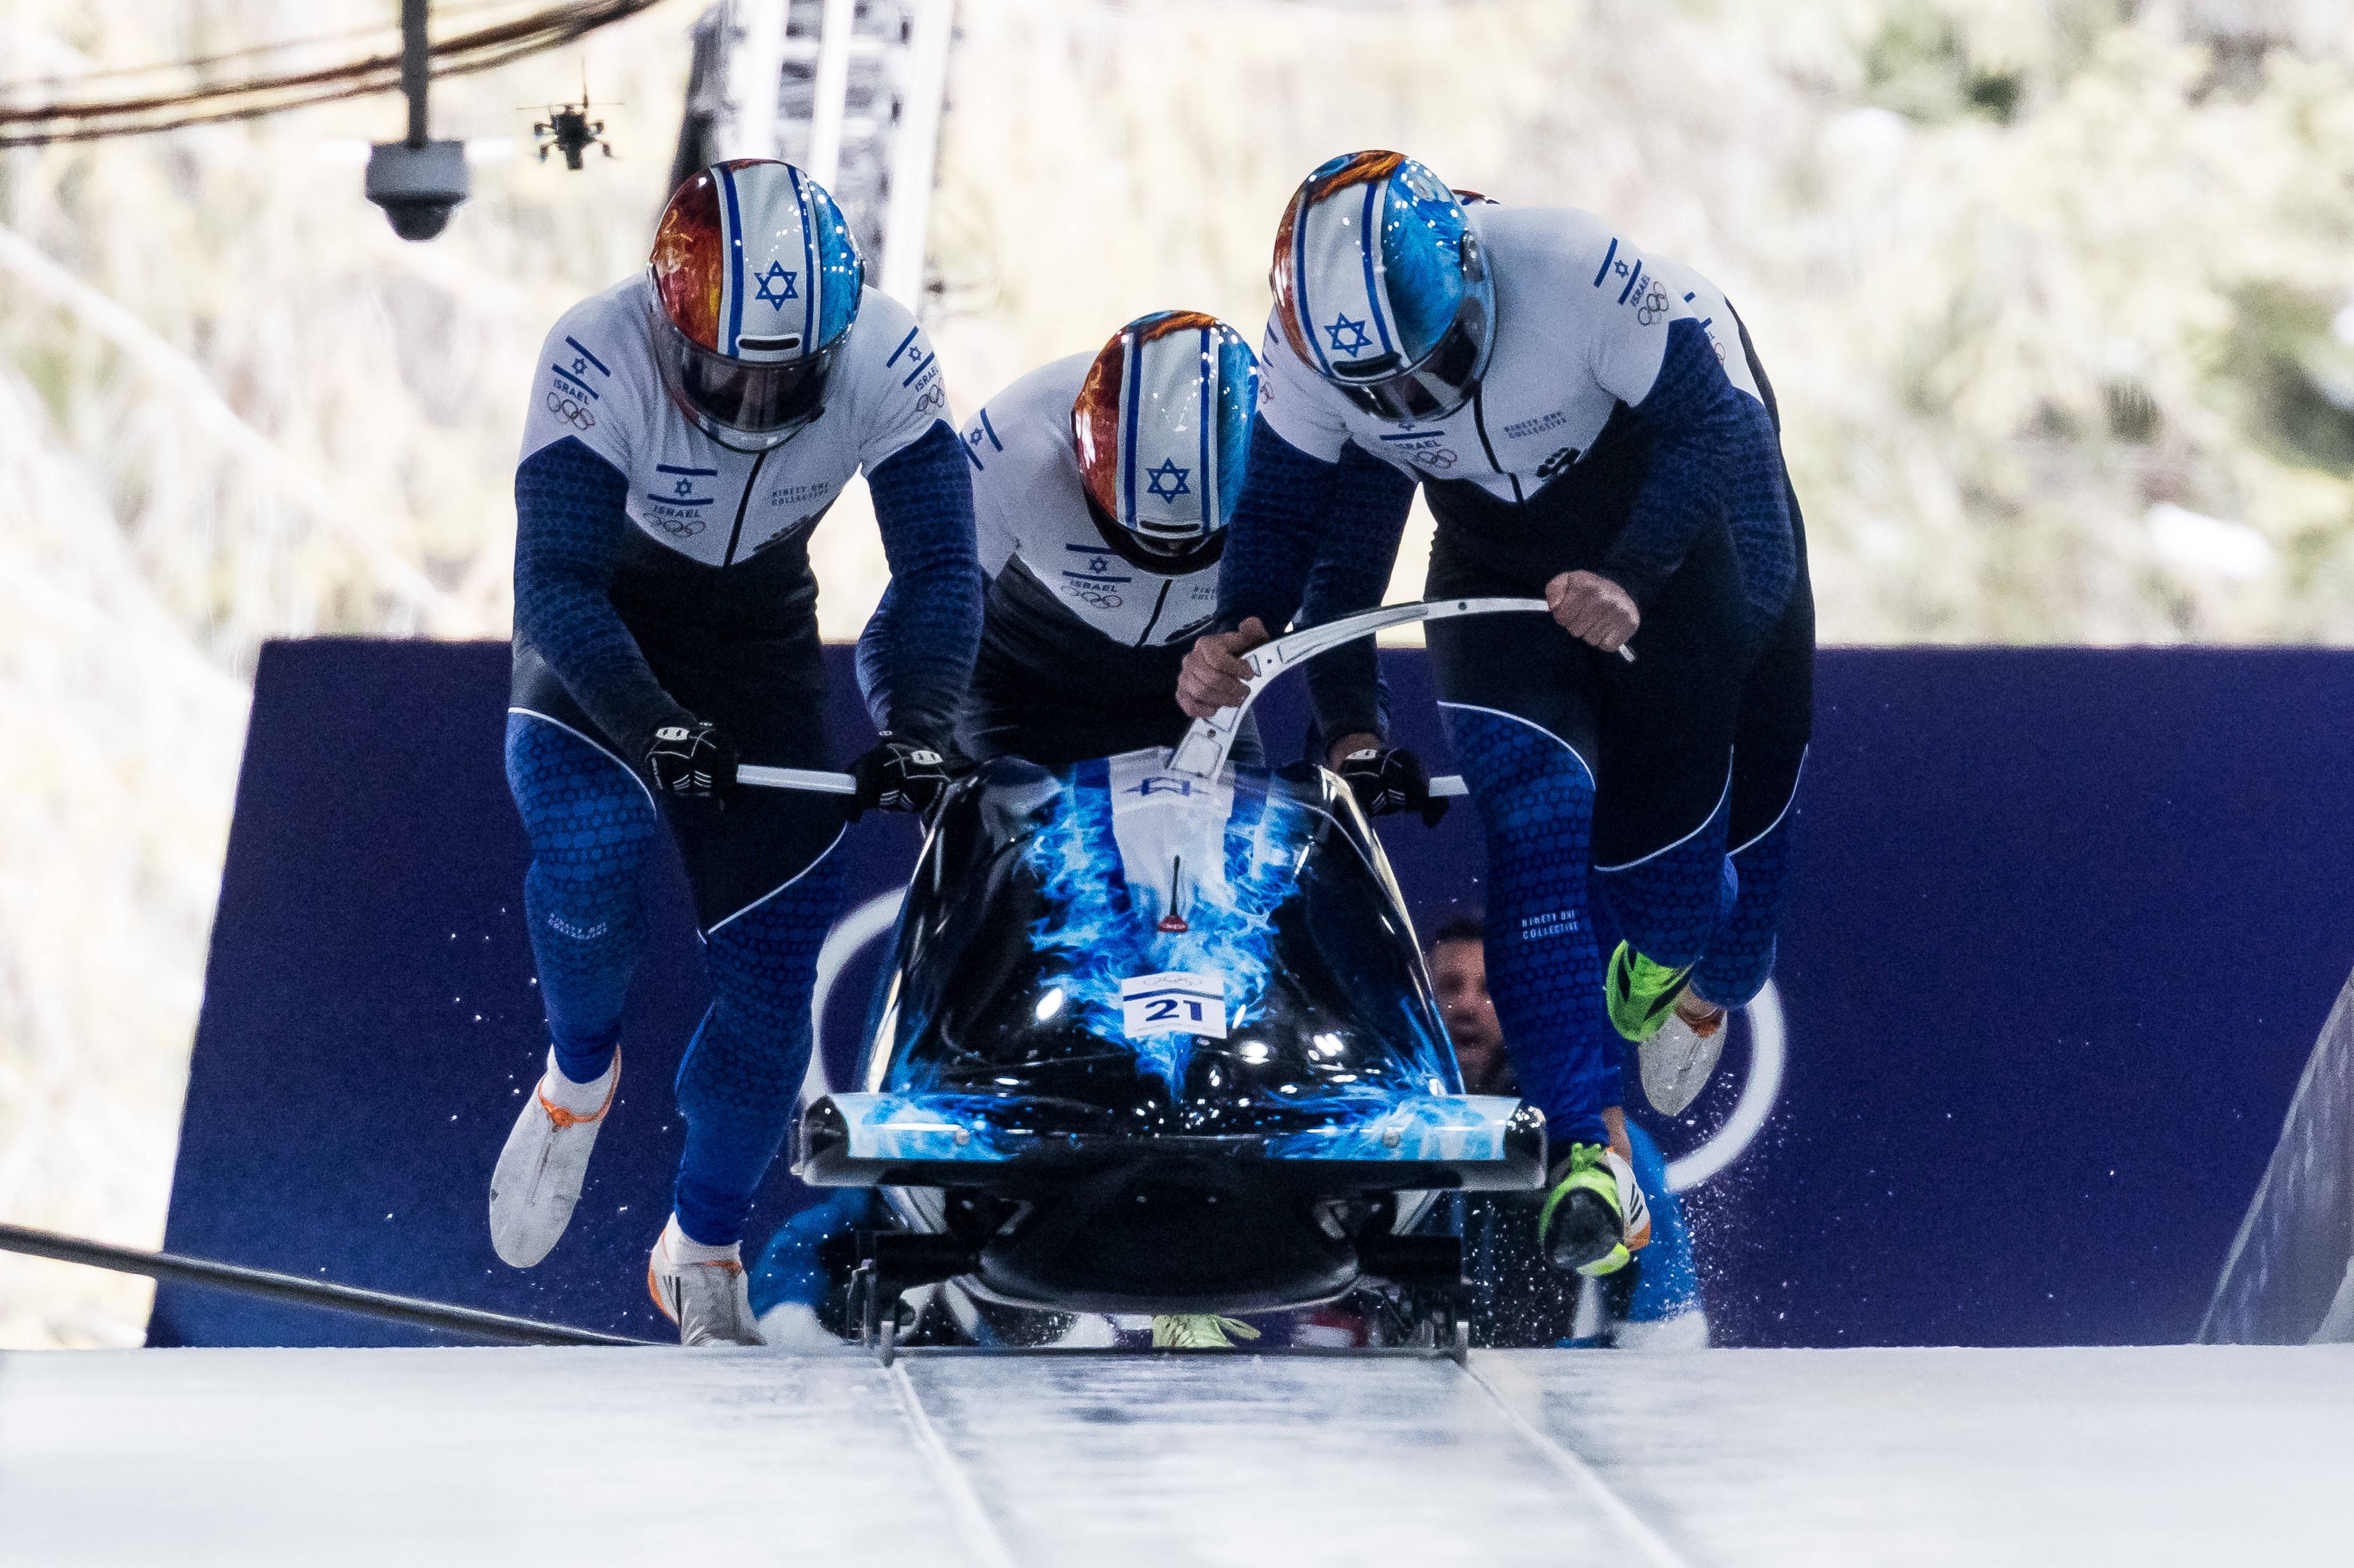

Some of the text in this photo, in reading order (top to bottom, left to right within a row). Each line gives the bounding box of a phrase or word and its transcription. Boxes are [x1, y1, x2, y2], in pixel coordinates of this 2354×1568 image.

[916, 365, 939, 392] ISRAEL
[553, 378, 589, 405] ISRAEL
[653, 506, 701, 518] ISRAEL
[1145, 999, 1203, 1021] 21
